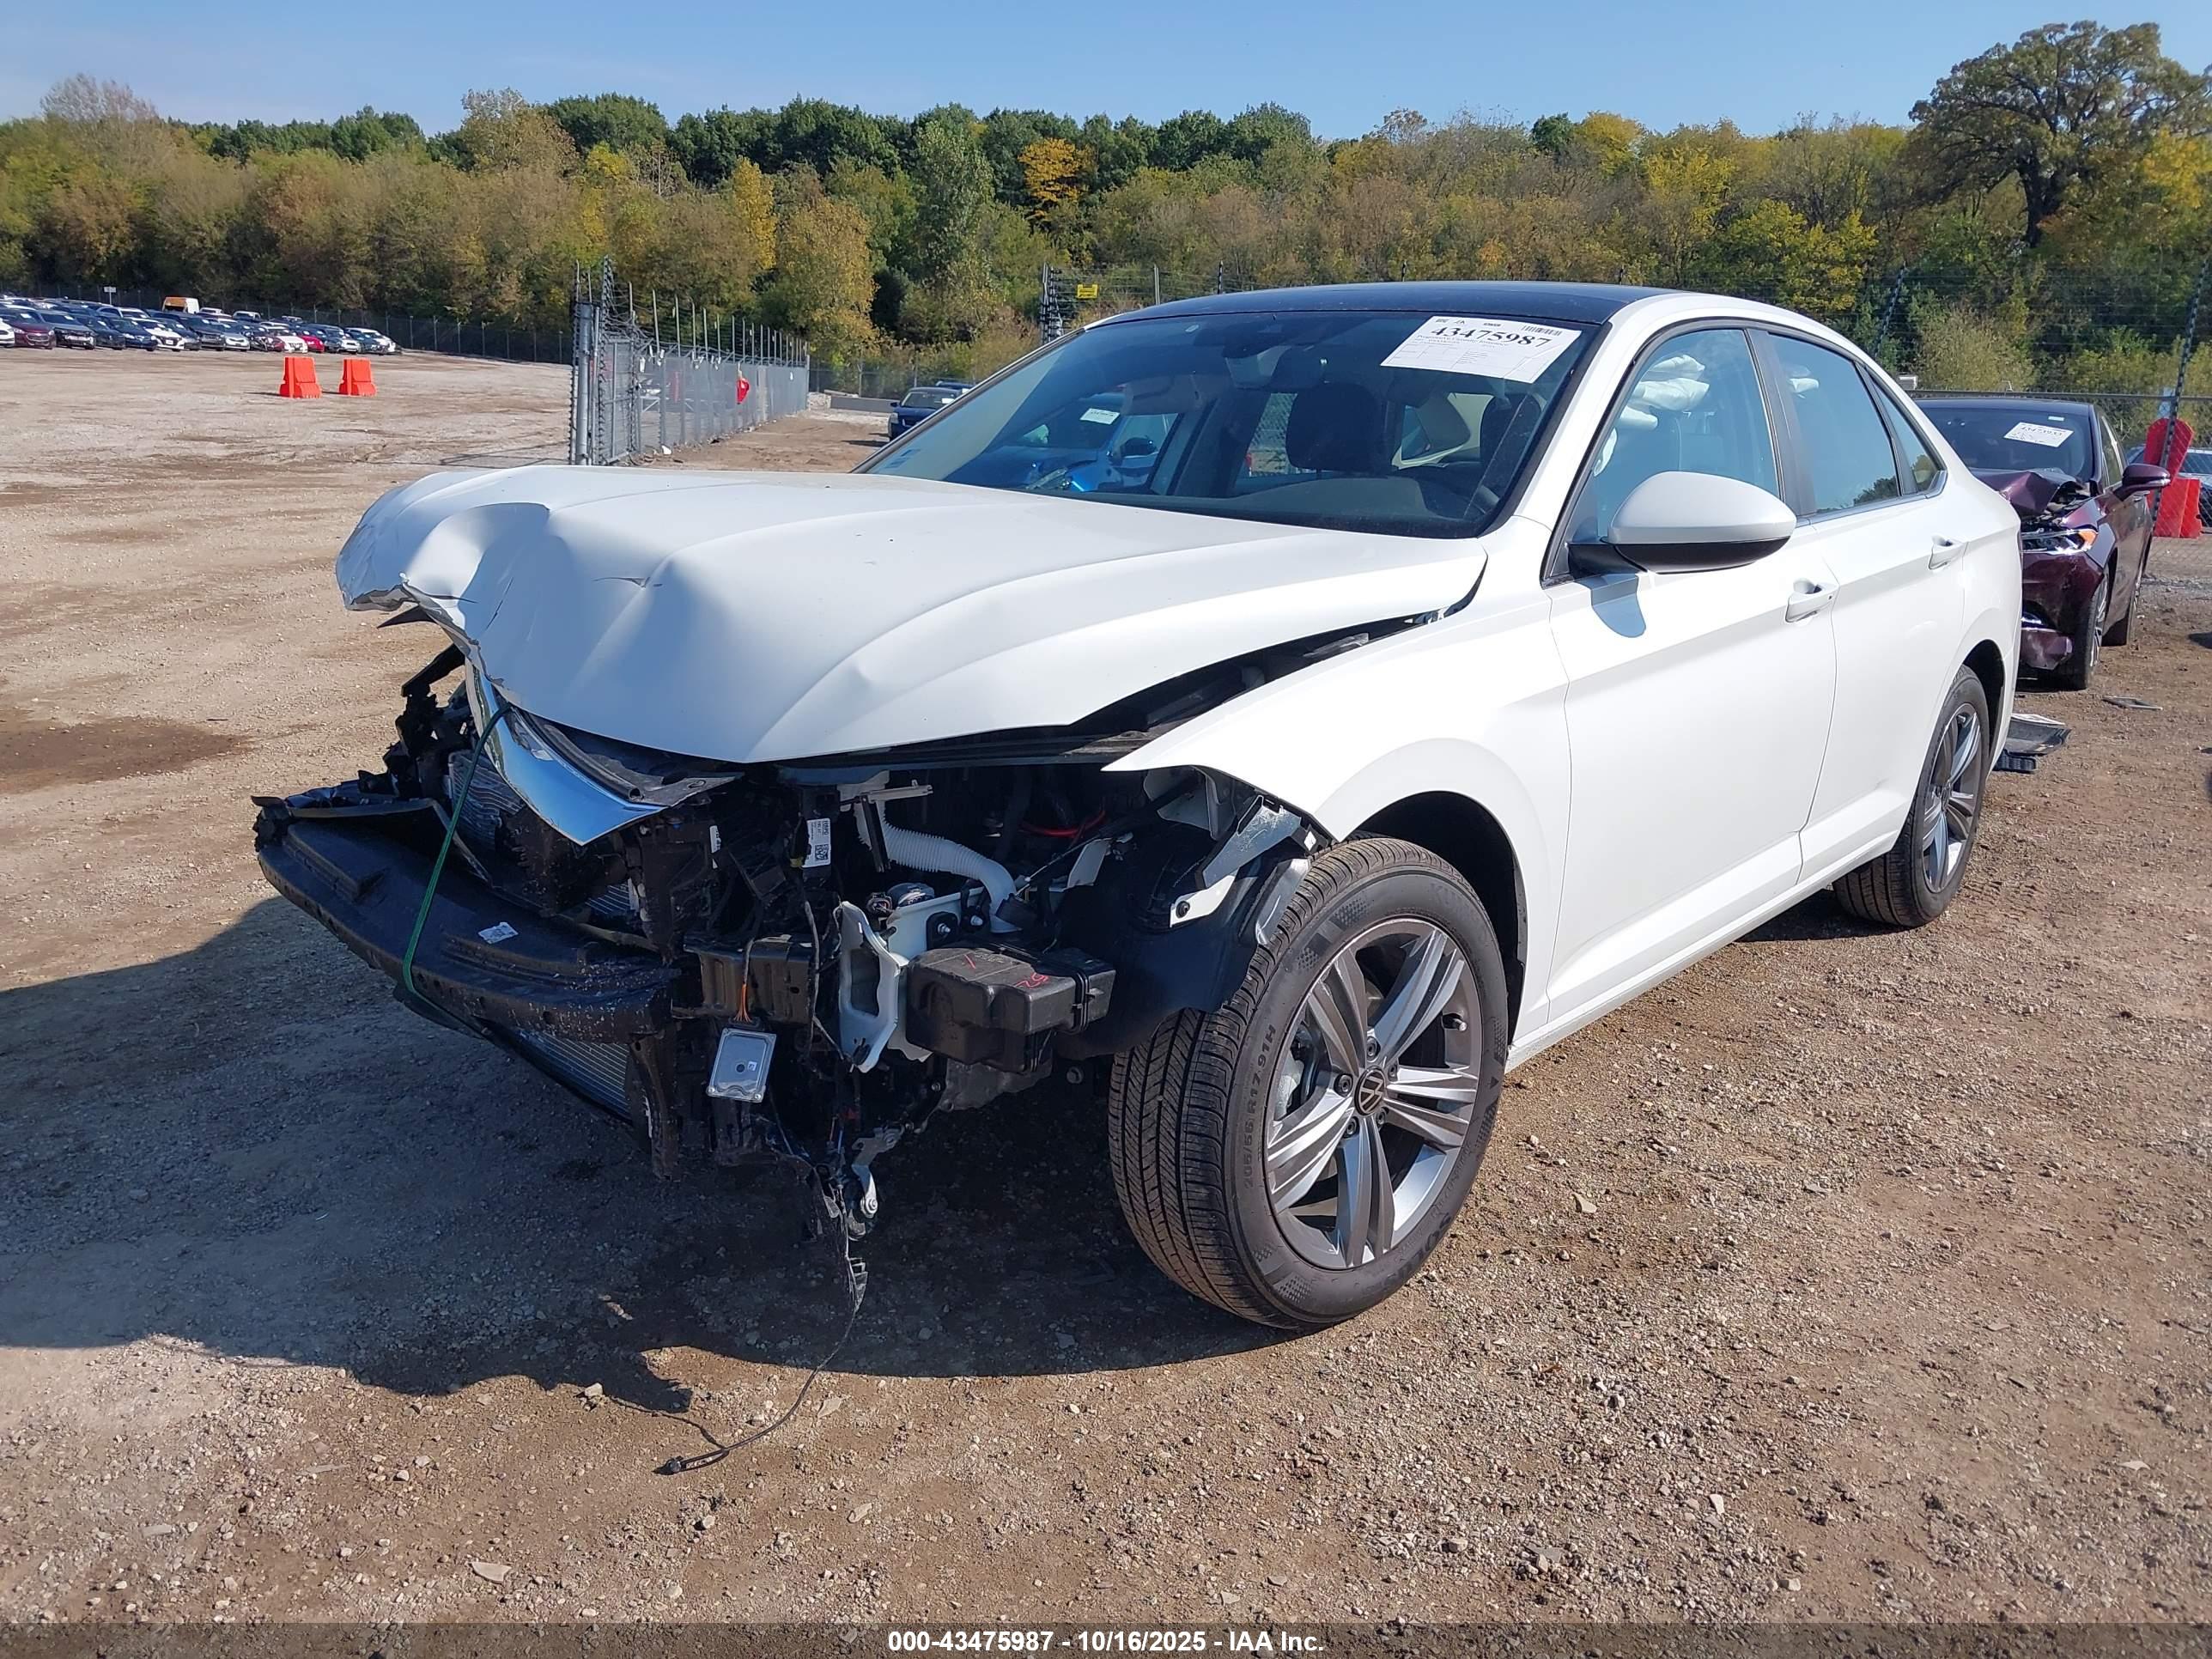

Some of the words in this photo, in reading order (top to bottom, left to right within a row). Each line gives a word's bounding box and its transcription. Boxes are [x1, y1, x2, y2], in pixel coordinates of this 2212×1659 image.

[1431, 326, 1552, 348] 43475987
[1246, 1071, 1261, 1115] R17
[1257, 1024, 1277, 1069] 91H
